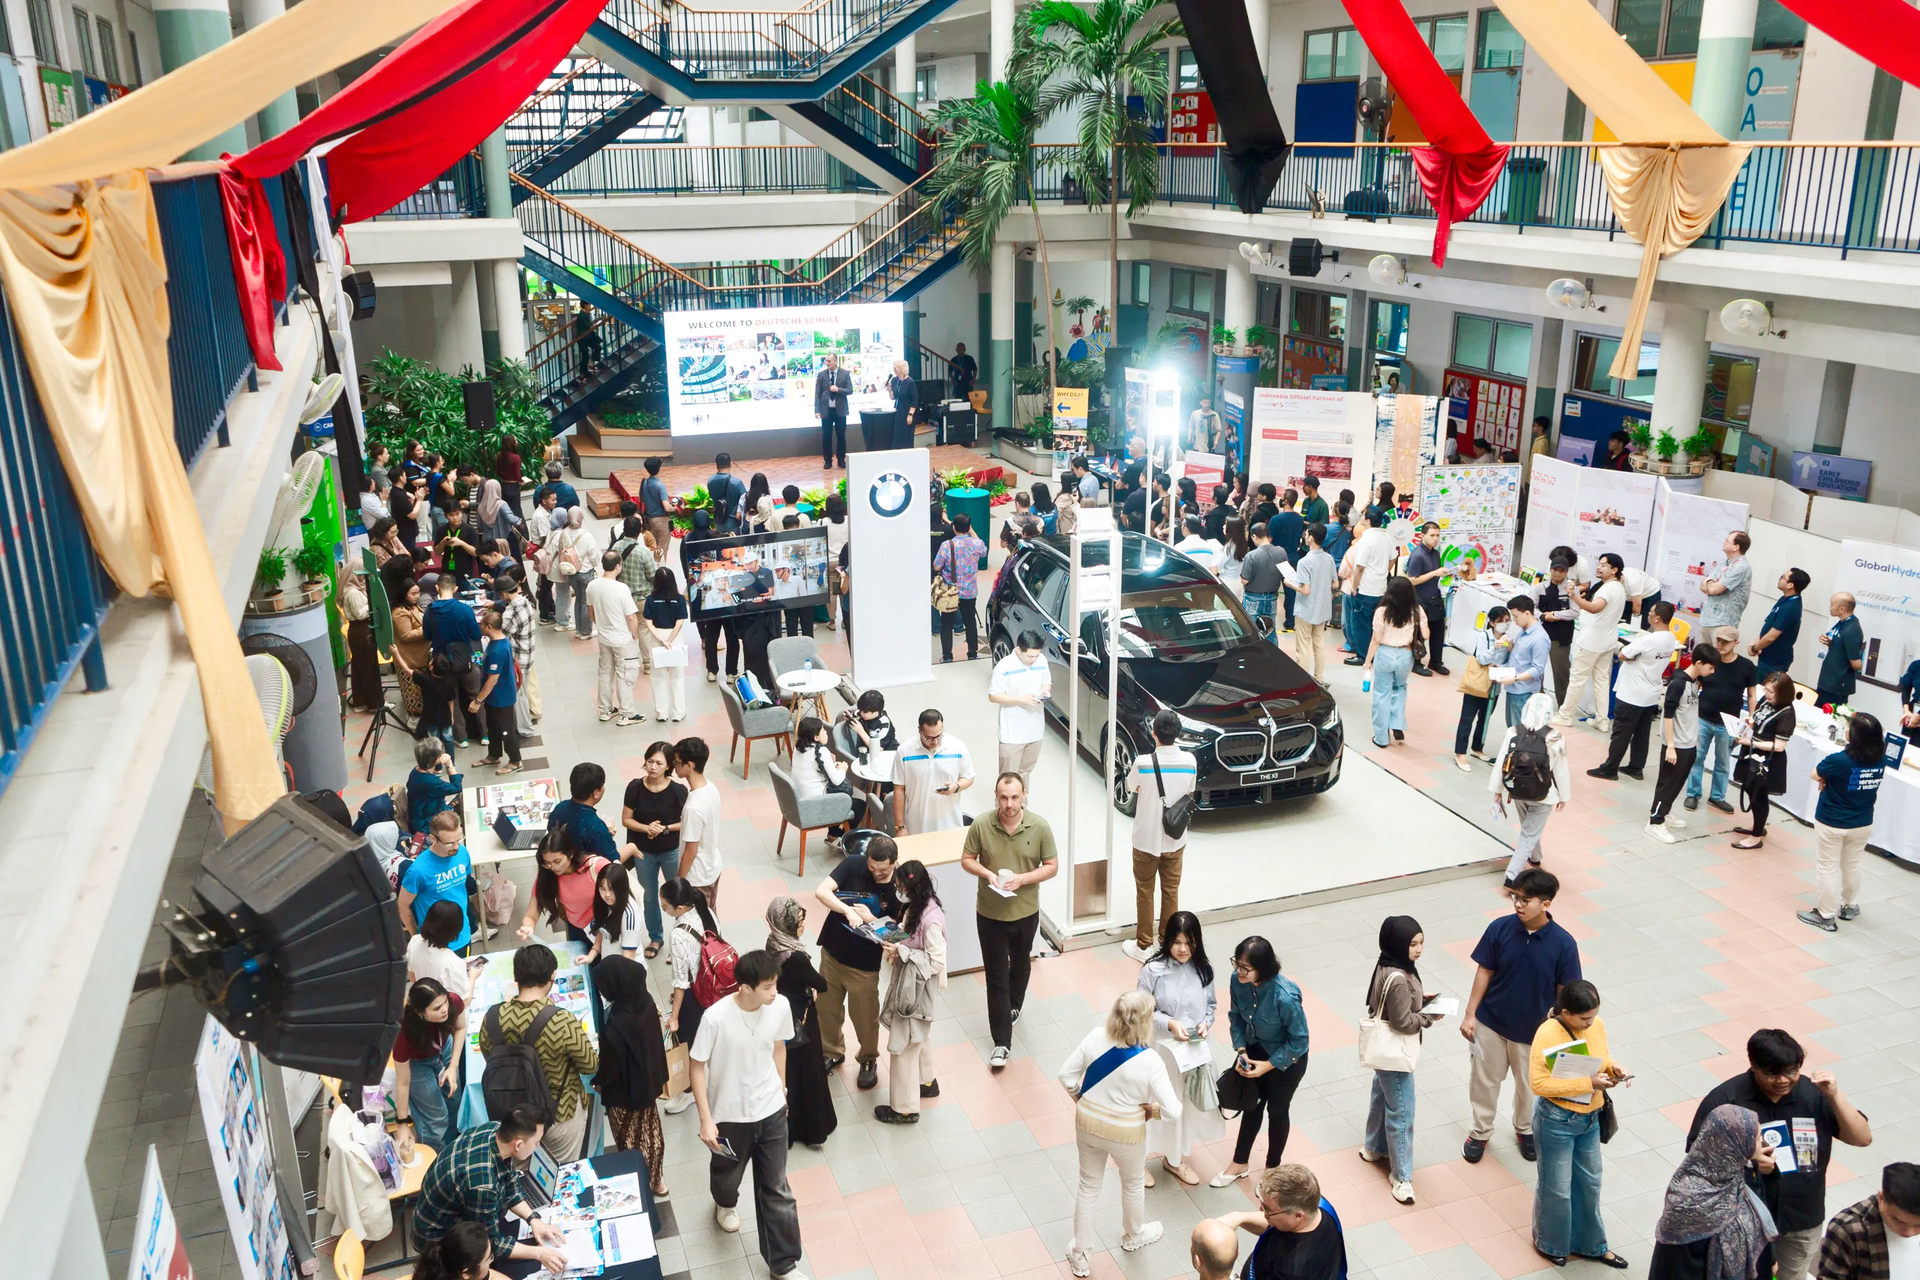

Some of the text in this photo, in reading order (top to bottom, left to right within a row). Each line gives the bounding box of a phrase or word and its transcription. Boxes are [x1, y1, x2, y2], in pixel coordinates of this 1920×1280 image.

[689, 315, 839, 329] WELCOME TO DEUTSCHE SCHULE
[1819, 469, 1841, 478] EARLY
[872, 473, 909, 489] BMW
[1817, 482, 1857, 492] EDUCATION
[1818, 475, 1860, 487] CHILDHOOD
[1856, 600, 1920, 618] Instant Power Plan
[434, 866, 457, 884] ZMT
